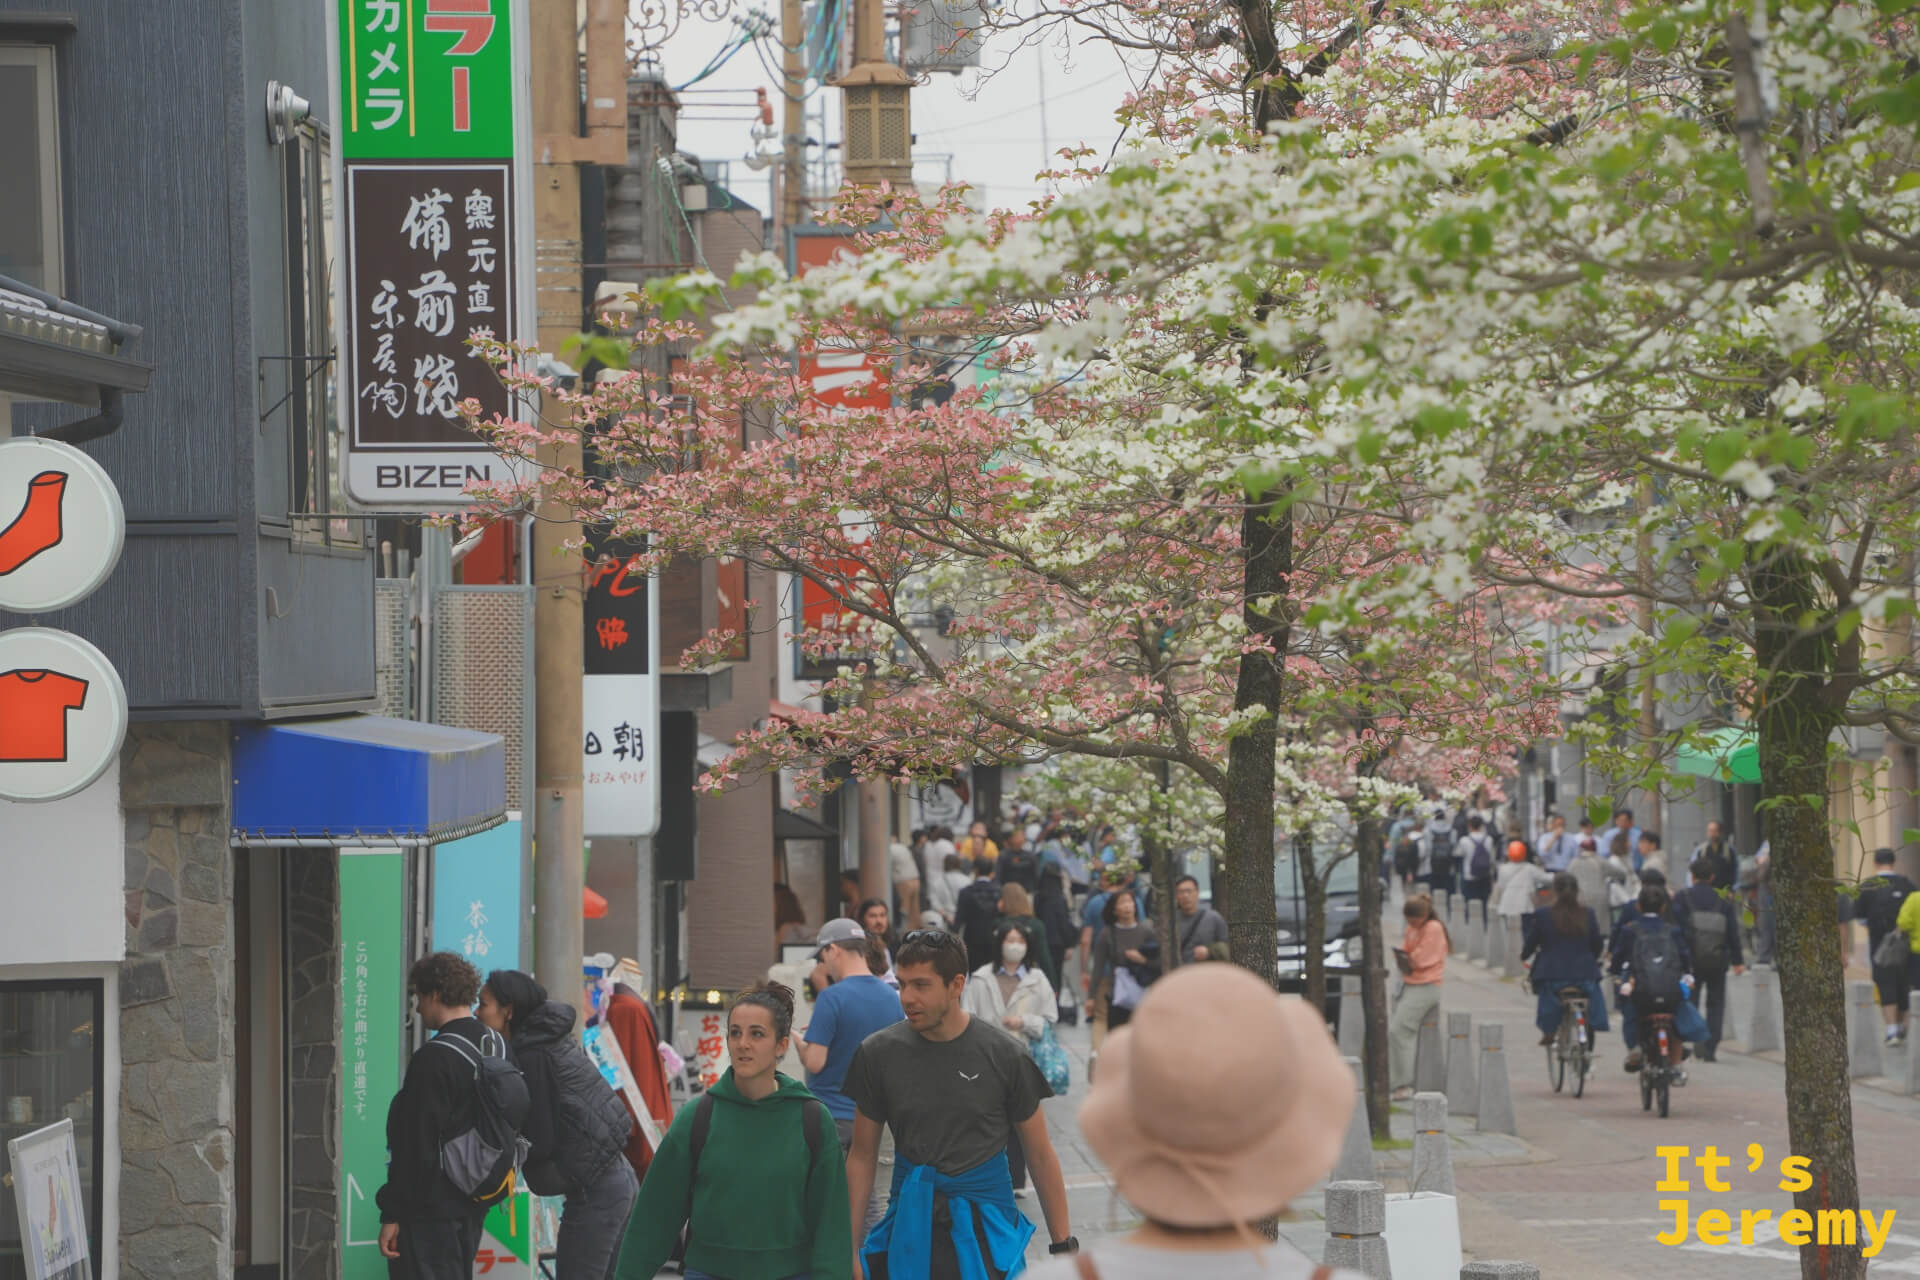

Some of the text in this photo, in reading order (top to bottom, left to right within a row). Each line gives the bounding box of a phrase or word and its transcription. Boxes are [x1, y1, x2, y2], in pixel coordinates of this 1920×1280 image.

[365, 0, 404, 130] カメラ
[376, 465, 490, 488] BIZEN
[589, 770, 647, 784] おみやげ
